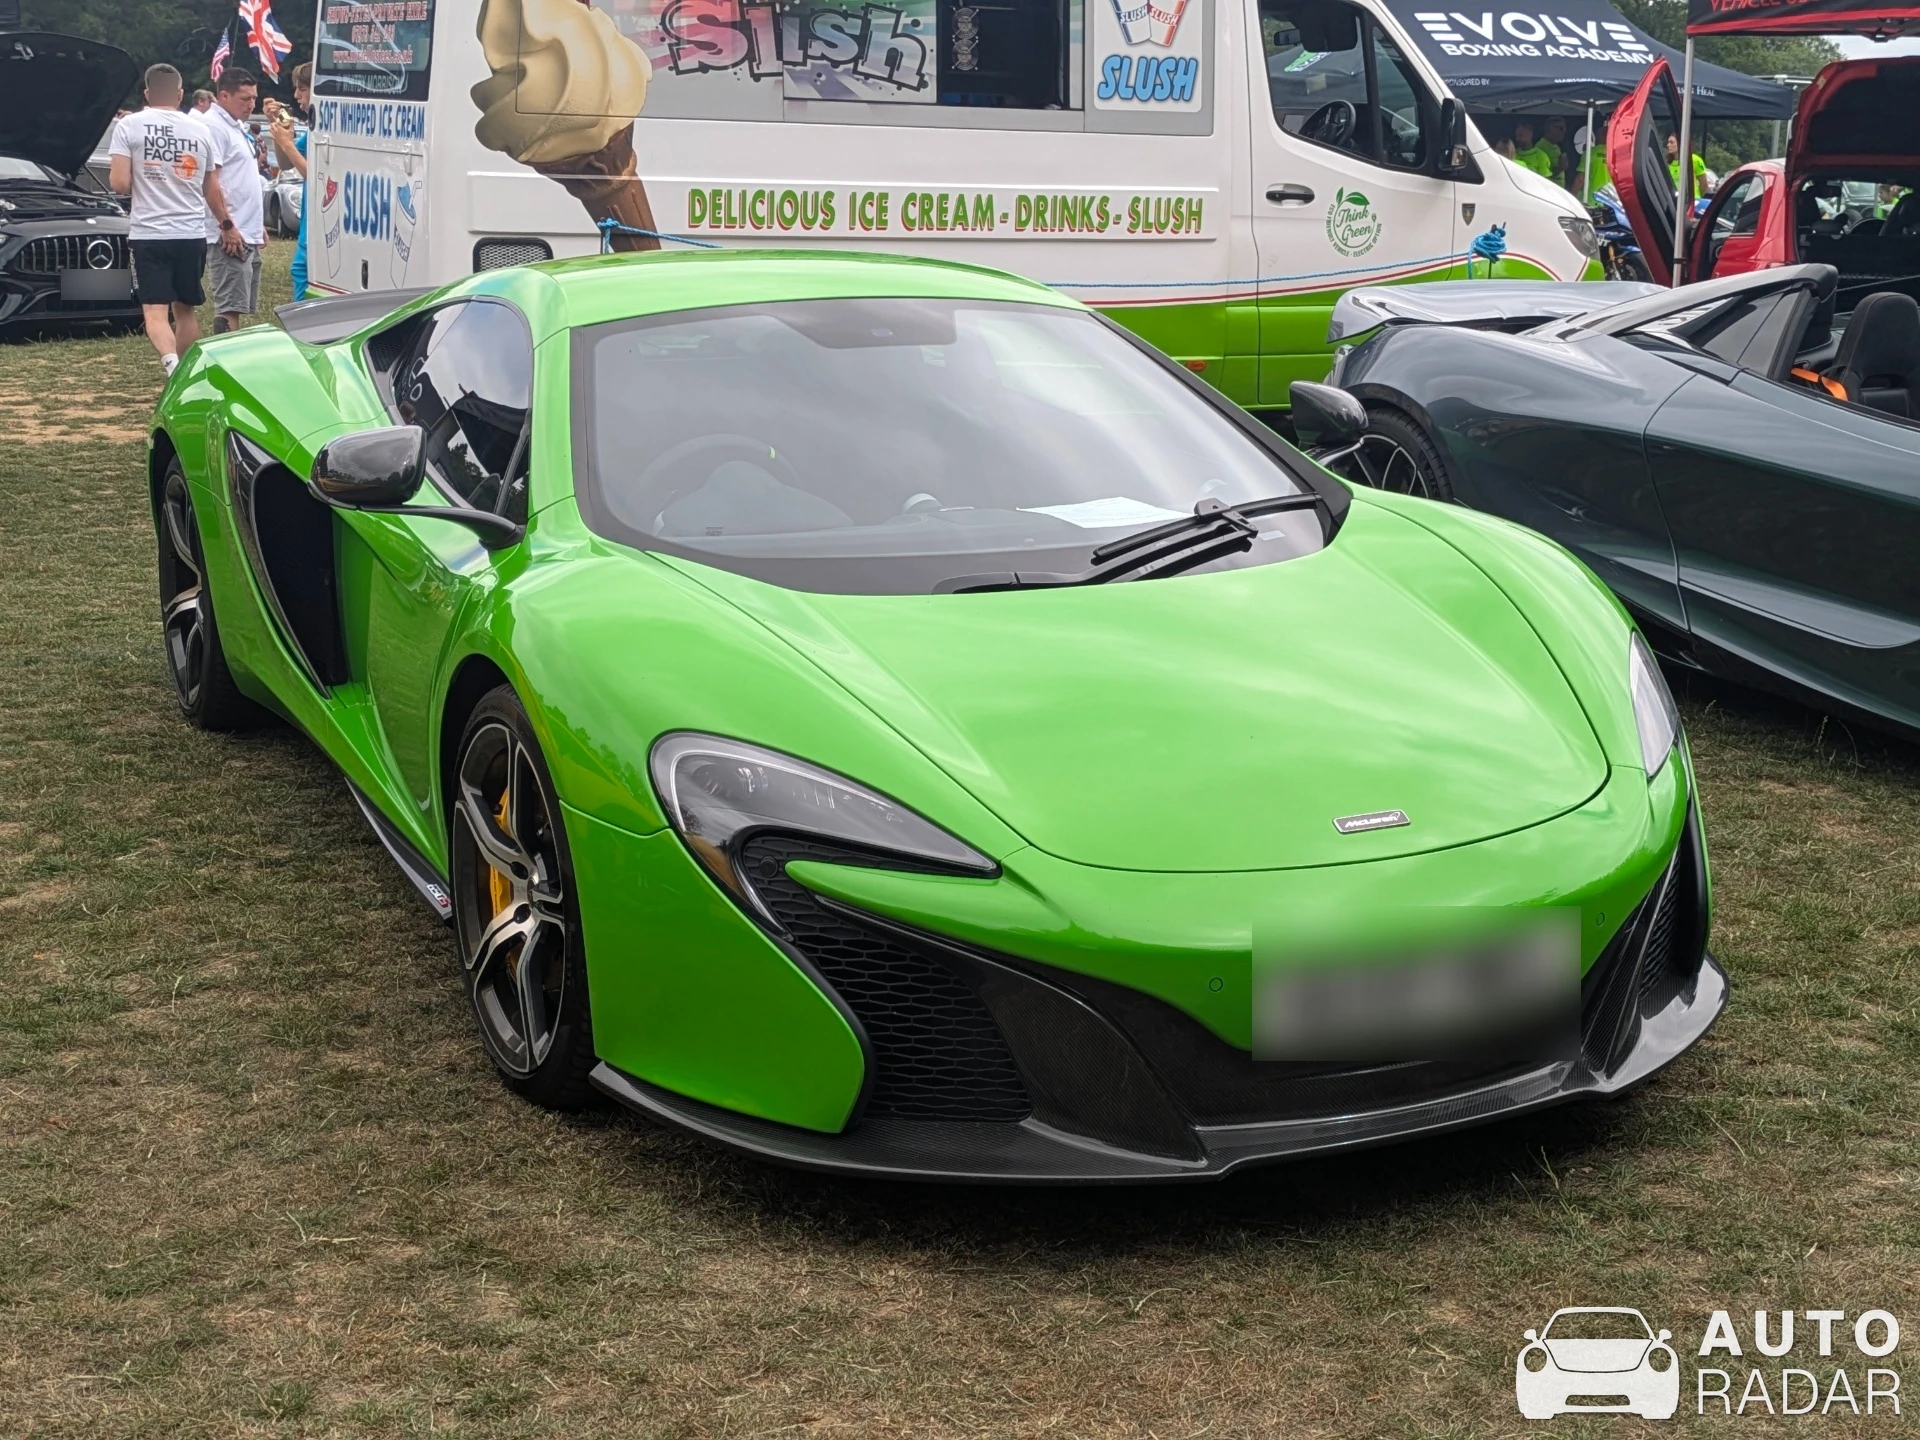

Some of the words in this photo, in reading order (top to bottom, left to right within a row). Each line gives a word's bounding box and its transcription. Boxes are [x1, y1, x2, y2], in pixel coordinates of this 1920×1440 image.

[1120, 4, 1149, 23] SLUSH
[1149, 7, 1179, 25] SLUSH
[1414, 12, 1650, 52] EVOLVE
[1440, 43, 1540, 57] BOXING
[1546, 44, 1656, 65] ACADEMY
[1097, 54, 1198, 102] SLUSH
[1481, 78, 1491, 86] BY
[143, 124, 174, 137] THE
[319, 100, 338, 132] SOFT
[340, 102, 376, 137] WHIPPED
[379, 104, 392, 138] ICE
[395, 105, 425, 140] CREAM
[144, 135, 198, 152] NORTH
[143, 147, 183, 163] FACE
[343, 170, 392, 242] SLUSH
[688, 188, 836, 231] DELICIOUS
[849, 191, 889, 232] ICE
[901, 192, 995, 232] CREAM
[1015, 194, 1110, 234] DRINKS
[1127, 196, 1203, 235] SLUSH
[1336, 205, 1370, 228] Think
[1342, 224, 1371, 246] Green
[1332, 241, 1350, 258] VEHICLE
